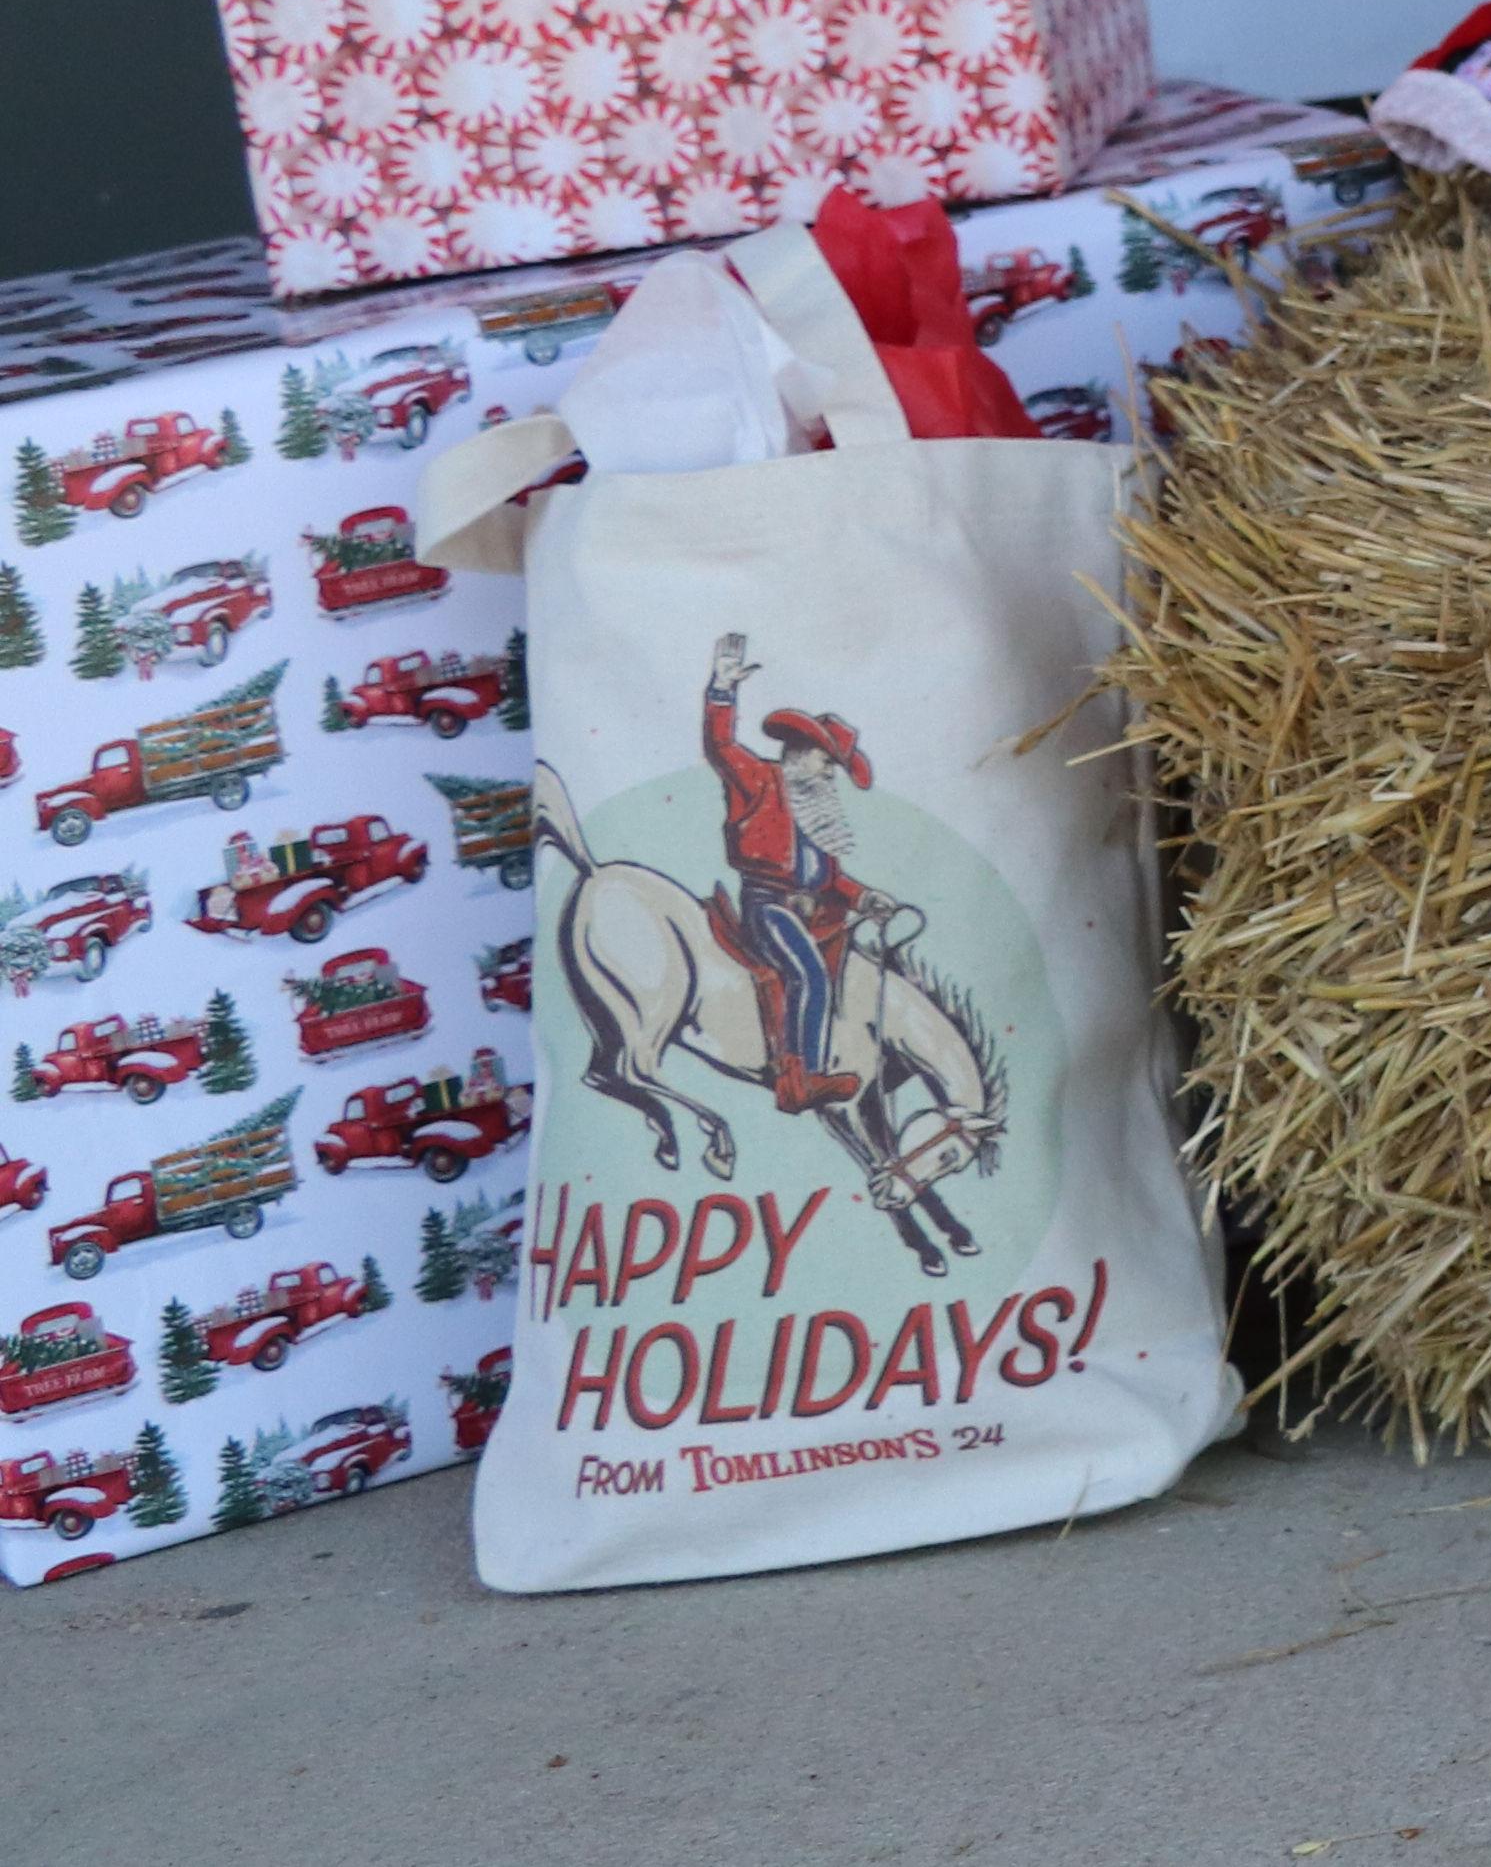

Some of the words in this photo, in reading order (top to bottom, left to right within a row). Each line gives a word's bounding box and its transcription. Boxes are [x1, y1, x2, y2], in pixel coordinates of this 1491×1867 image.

[530, 1182, 830, 1322] HAPPY
[557, 1258, 1108, 1431] HOLIDAYS!
[576, 1455, 665, 1499] FROM
[679, 1430, 942, 1492] TOMLINSON'S
